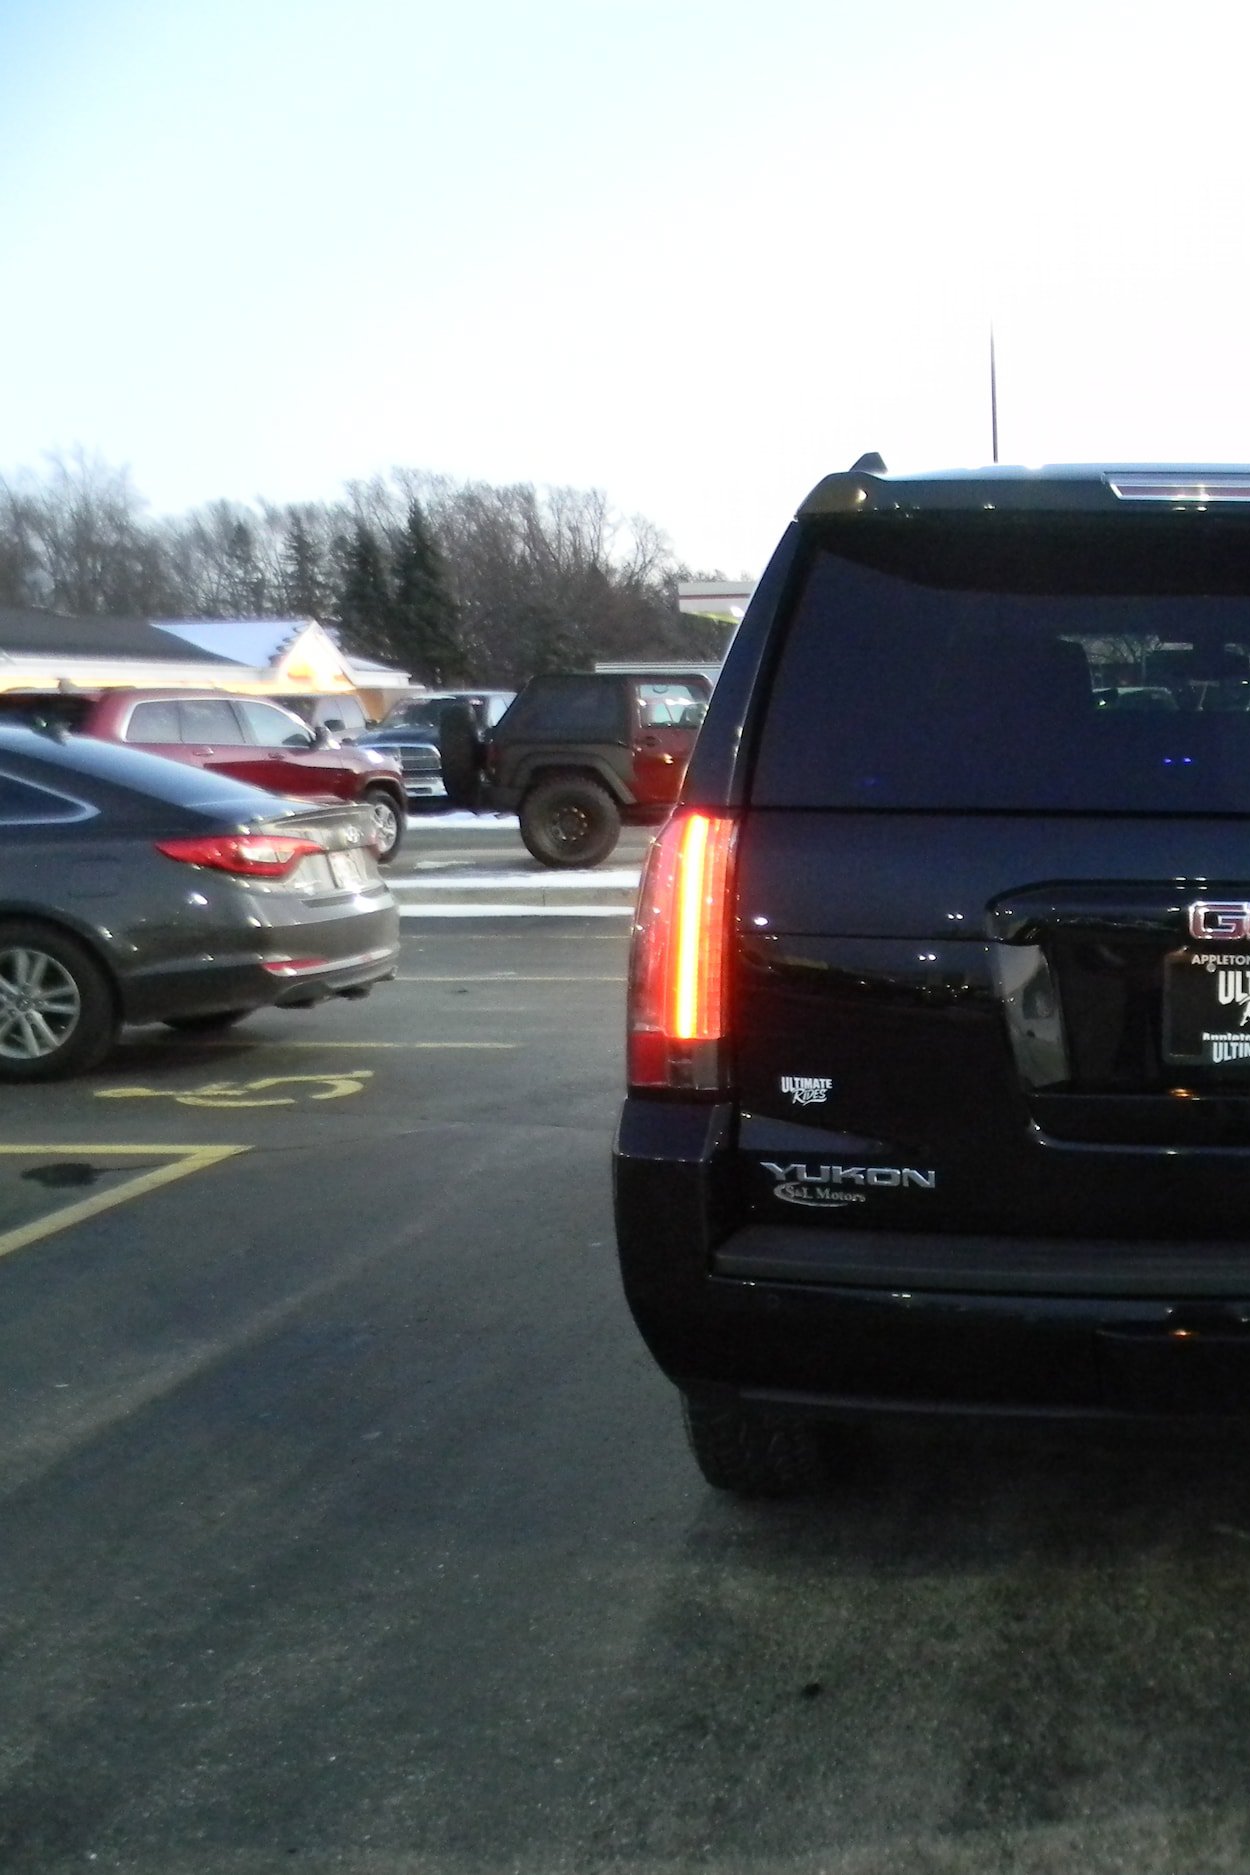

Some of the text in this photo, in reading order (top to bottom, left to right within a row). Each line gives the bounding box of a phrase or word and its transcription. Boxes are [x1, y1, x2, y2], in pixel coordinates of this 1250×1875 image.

[781, 1076, 833, 1093] ULTIMATE
[759, 1161, 936, 1188] YUKON
[816, 1186, 866, 1202] Motors
